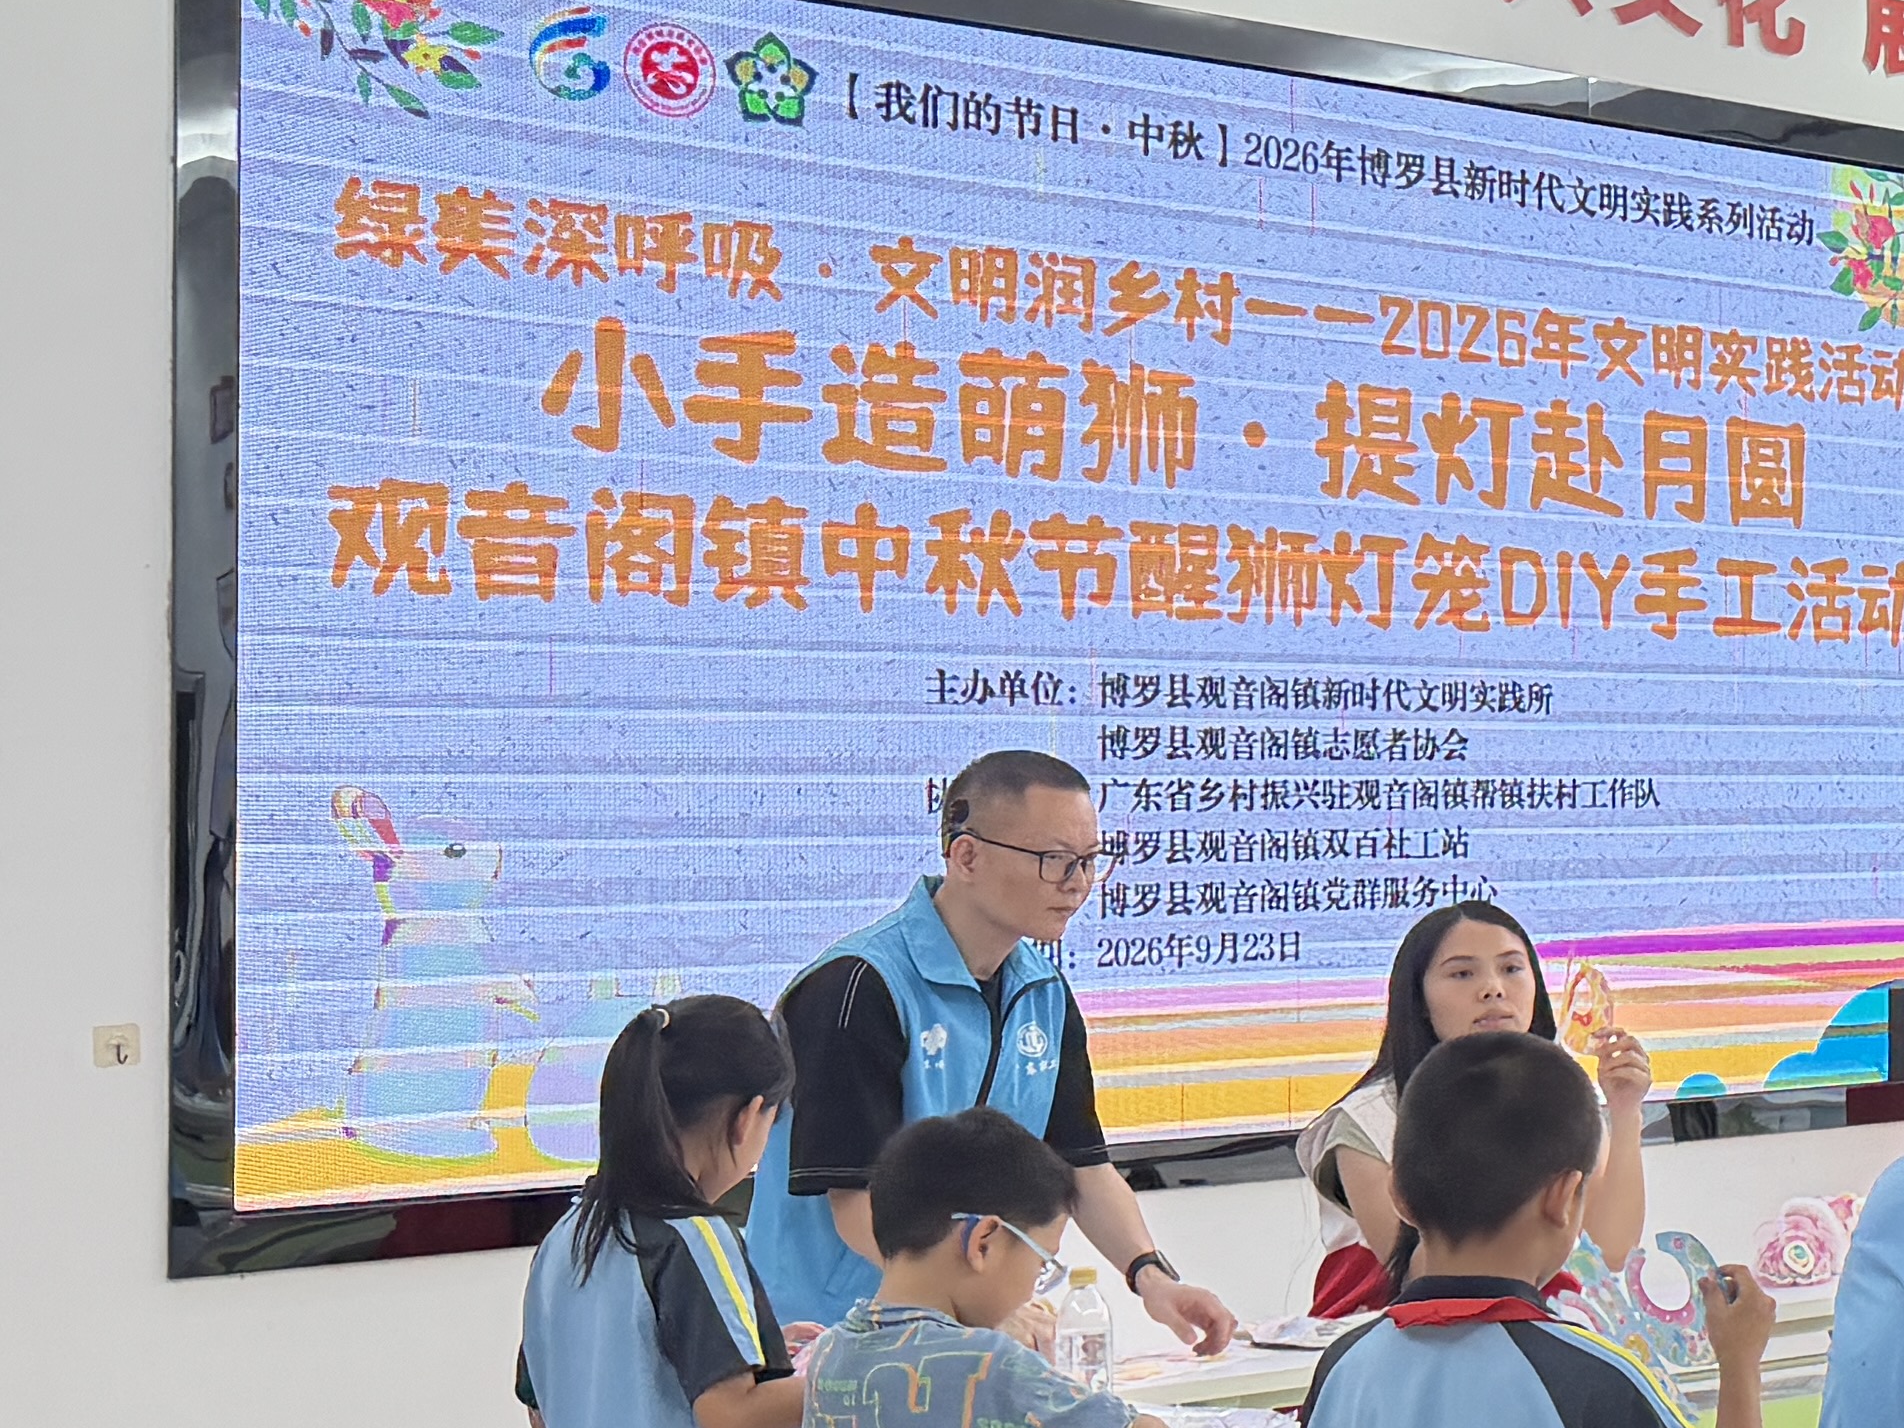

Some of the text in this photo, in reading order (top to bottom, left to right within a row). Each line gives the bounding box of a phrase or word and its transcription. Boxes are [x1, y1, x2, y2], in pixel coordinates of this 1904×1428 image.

[541, 316, 1806, 530] 小手造萌狮·提灯赴月圆
[1096, 723, 1469, 763] 博罗县观音阁镇志愿者协会
[1097, 776, 1661, 814] 广东省乡村振兴驻观音阁镇帮镇扶村工作队
[1098, 824, 1470, 866] 博罗县观音阁镇双百社工站
[1096, 873, 1499, 920] 博罗县观音阁镇党群服务中心
